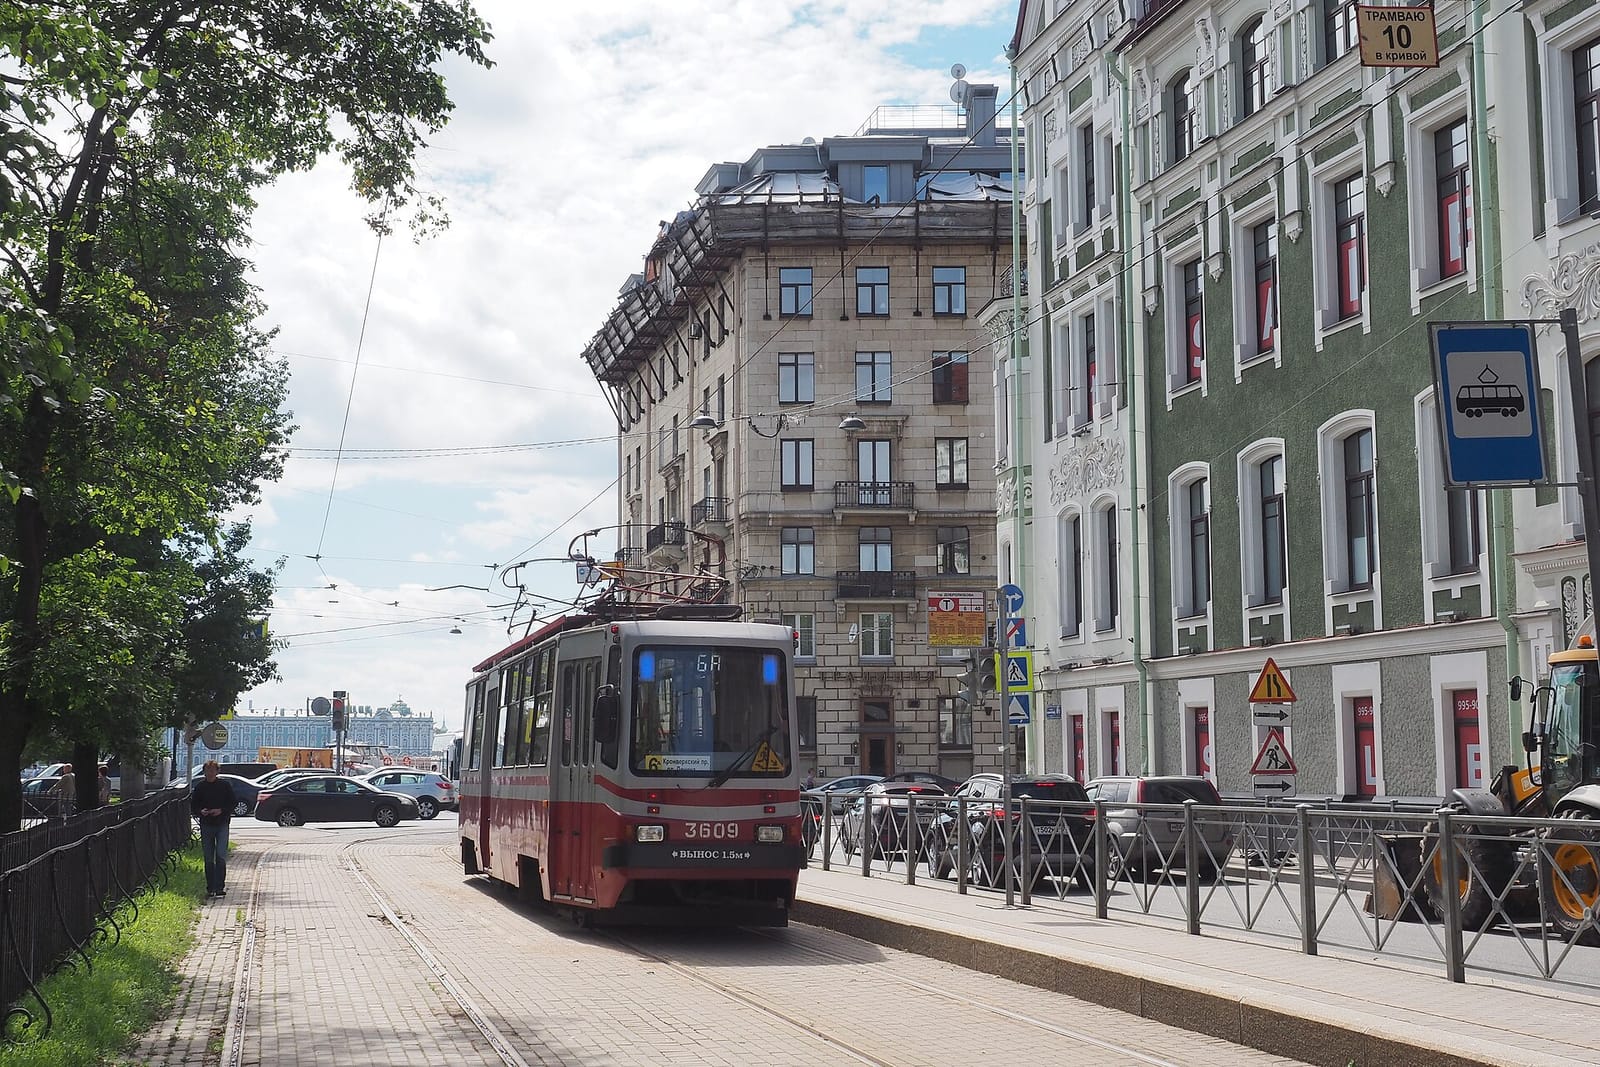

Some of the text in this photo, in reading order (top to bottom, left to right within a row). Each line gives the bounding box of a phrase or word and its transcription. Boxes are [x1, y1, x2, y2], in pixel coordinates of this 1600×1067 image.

[1365, 10, 1426, 22] ТРАМВАЮ
[1382, 24, 1412, 49] 10
[1375, 50, 1427, 62] в кривой
[684, 822, 739, 839] 3609
[679, 850, 743, 859] ВЫНОС 1.5м
